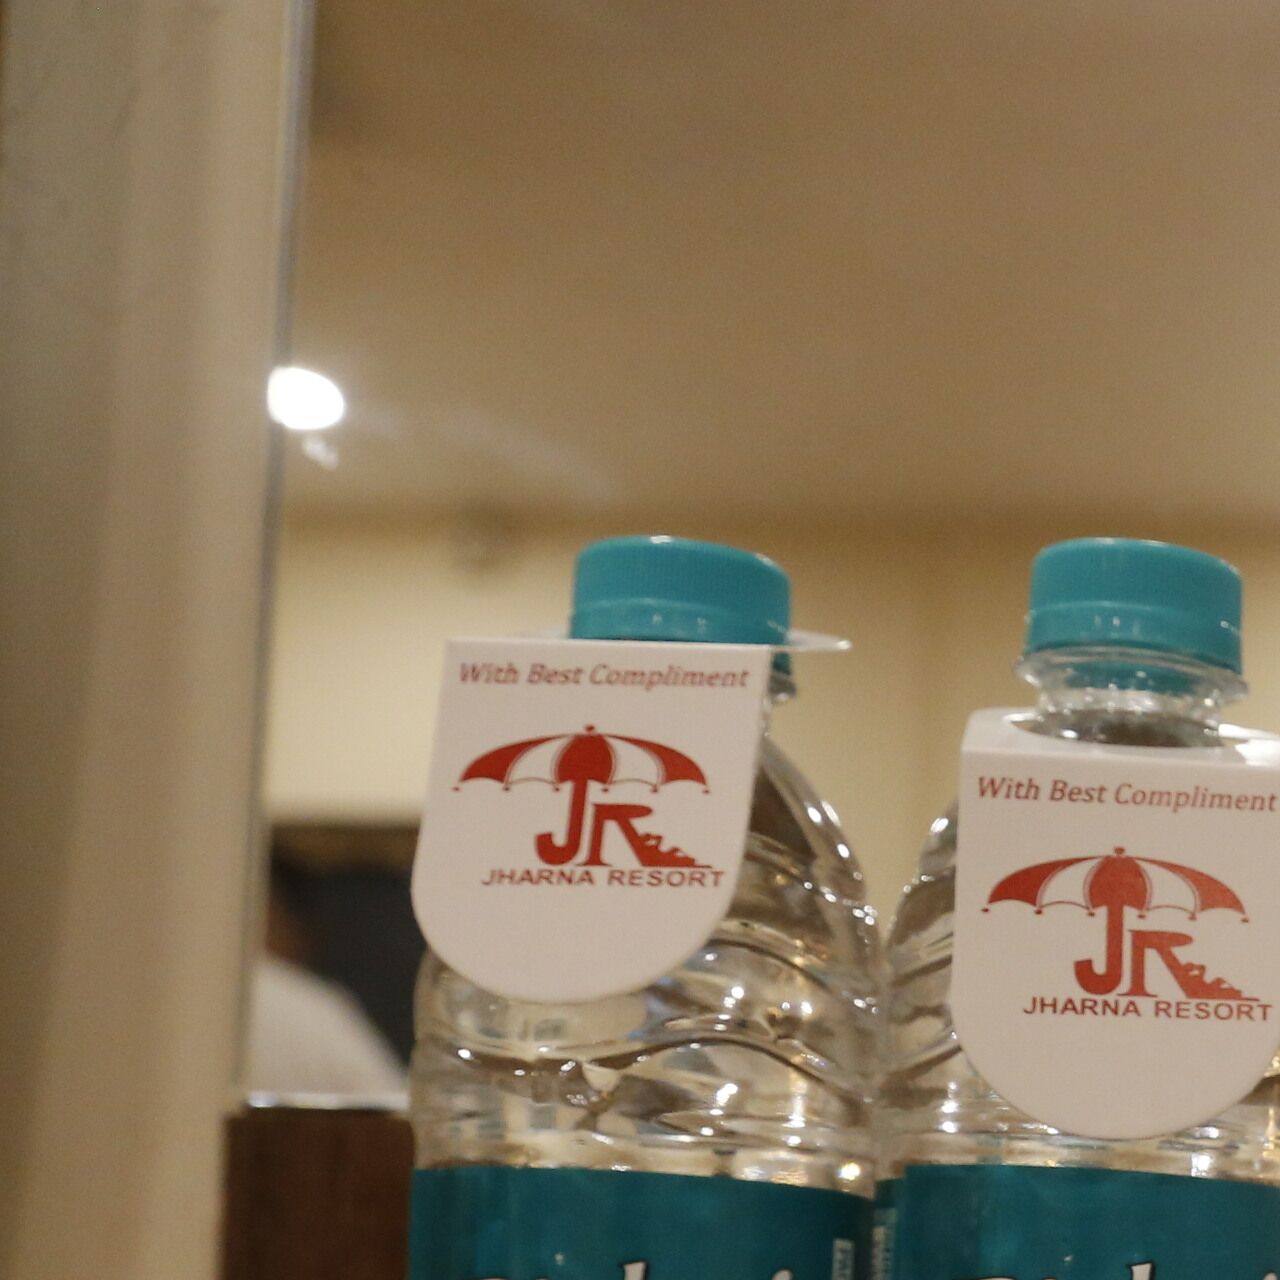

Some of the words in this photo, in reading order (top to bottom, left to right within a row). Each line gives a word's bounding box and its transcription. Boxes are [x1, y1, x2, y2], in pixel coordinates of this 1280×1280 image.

[460, 662, 519, 685] With
[528, 663, 583, 685] Best
[589, 664, 751, 690] Compliment
[977, 776, 1040, 801] With
[1050, 780, 1107, 804] Best
[1114, 783, 1278, 812] Compliment
[482, 868, 595, 887] JHARNA
[607, 870, 725, 888] RESORT
[1023, 997, 1141, 1018] JHARNA
[1154, 1001, 1272, 1022] RESORT
